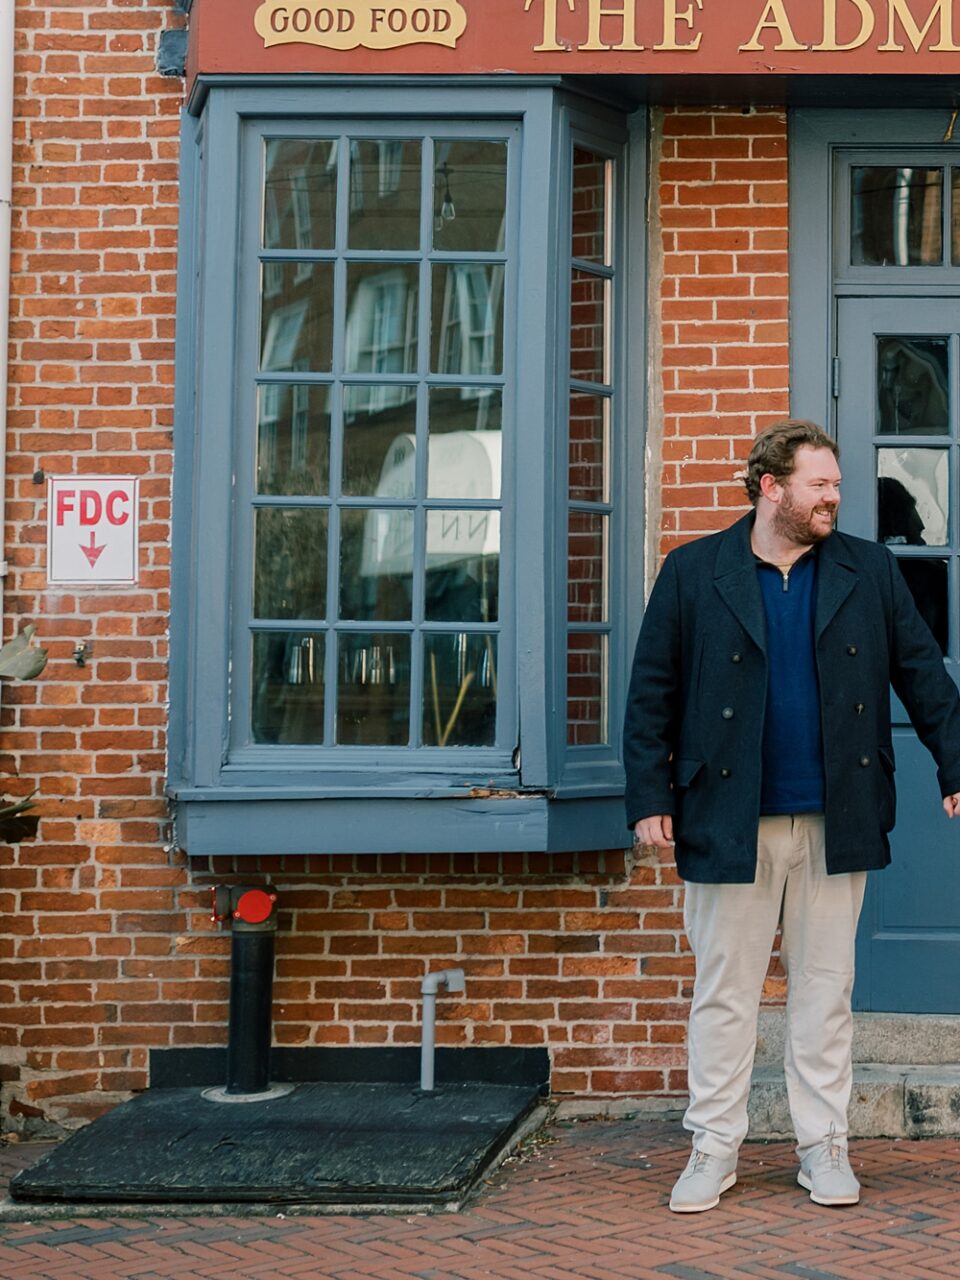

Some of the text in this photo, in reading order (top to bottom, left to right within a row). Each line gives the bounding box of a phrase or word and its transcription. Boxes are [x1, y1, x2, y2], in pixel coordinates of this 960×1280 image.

[270, 7, 452, 33] GOOD FOOD
[56, 490, 130, 526] FDC
